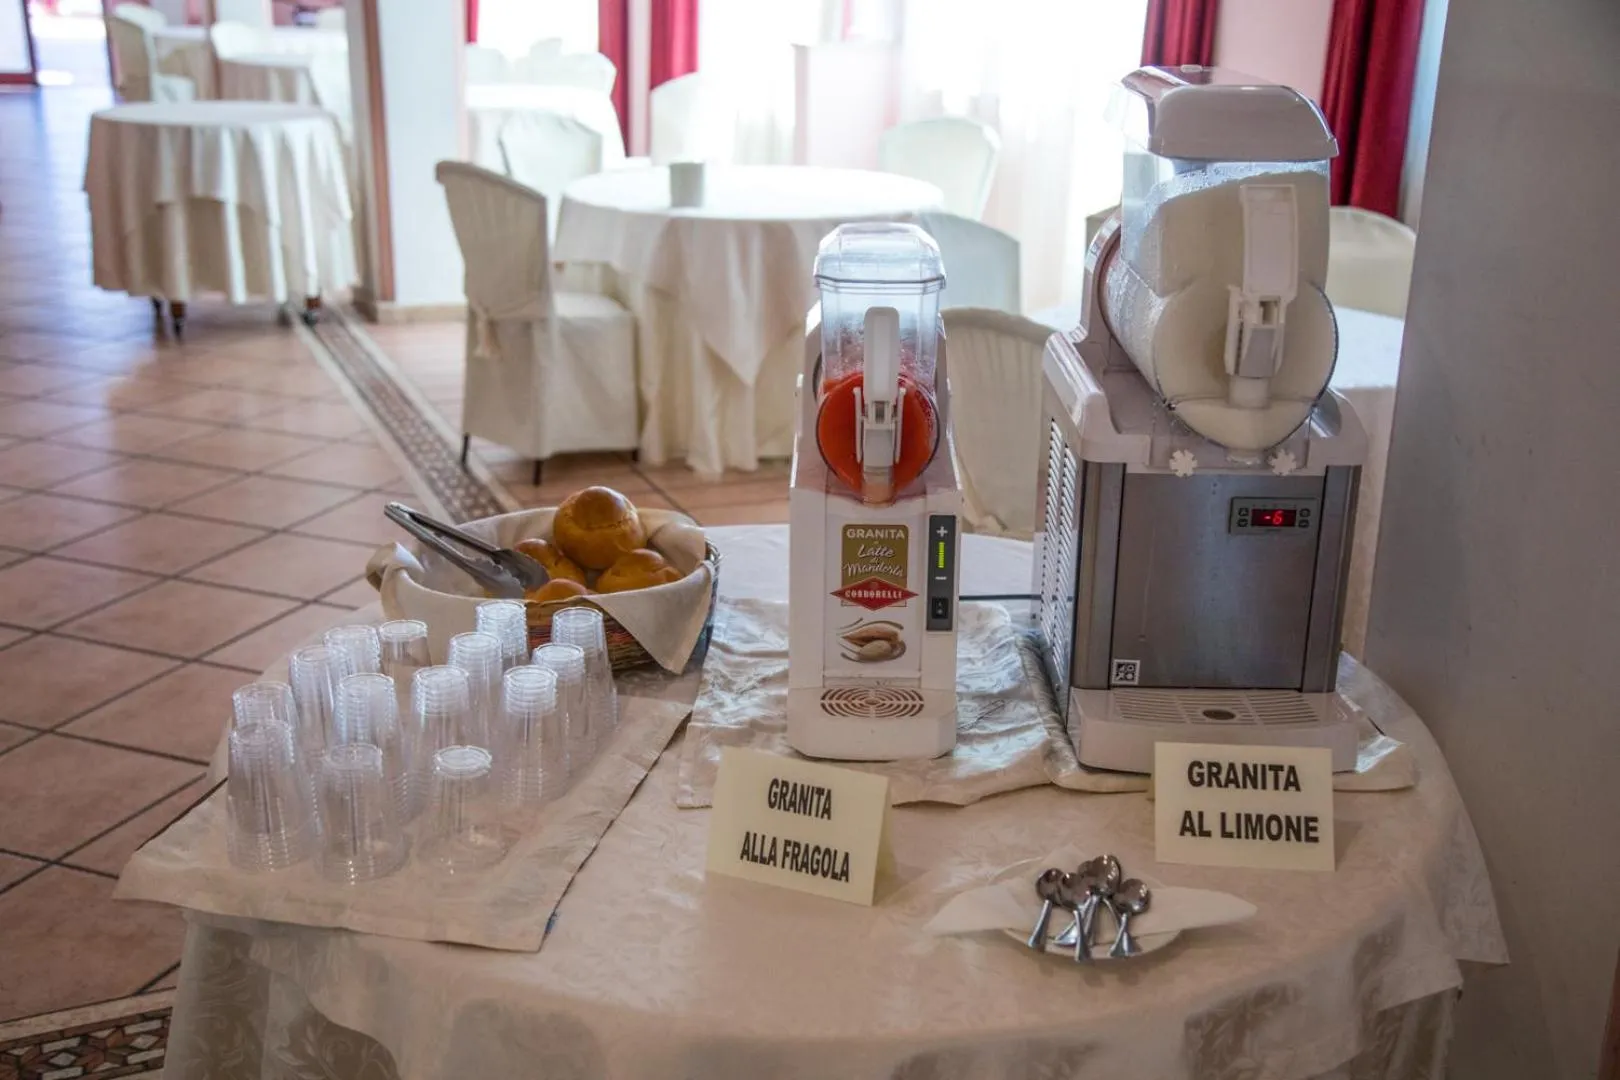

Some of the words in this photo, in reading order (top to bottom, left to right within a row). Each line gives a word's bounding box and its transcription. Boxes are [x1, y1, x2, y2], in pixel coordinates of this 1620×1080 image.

[846, 528, 905, 539] GRANITA
[857, 544, 895, 558] Latte
[1187, 760, 1302, 792] GRANITA
[767, 778, 832, 820] GRANITA
[1179, 810, 1212, 838] AL
[1220, 812, 1319, 843] LIMONE
[740, 831, 777, 867] ALLA
[781, 839, 850, 883] FRAGOLA
